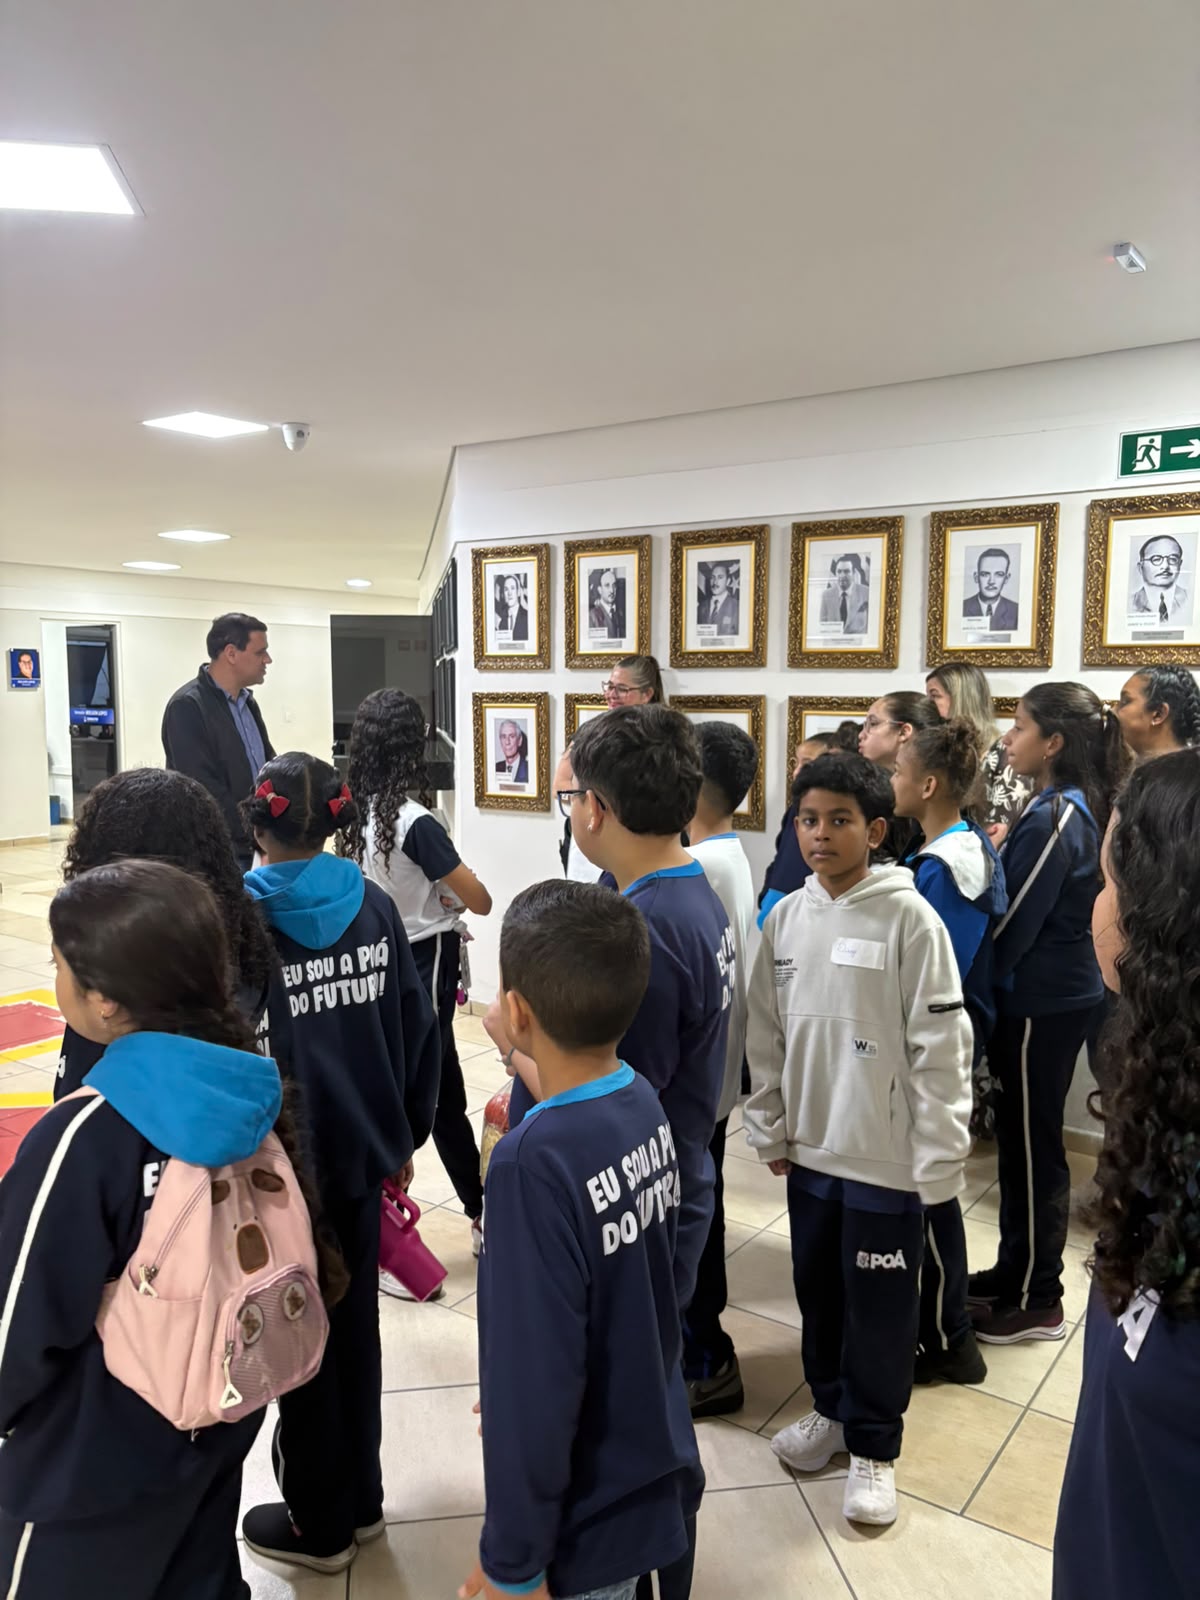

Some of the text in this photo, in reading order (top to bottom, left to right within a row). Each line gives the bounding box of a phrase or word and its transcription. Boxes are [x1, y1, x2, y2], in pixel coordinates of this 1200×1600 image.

[281, 963, 303, 988] EU
[306, 956, 335, 982] SOU
[340, 953, 354, 976] A
[289, 992, 310, 1018] DO
[586, 1166, 621, 1214] EU
[621, 1143, 651, 1192] SOU
[649, 1137, 662, 1173] A
[602, 1210, 639, 1256] DO
